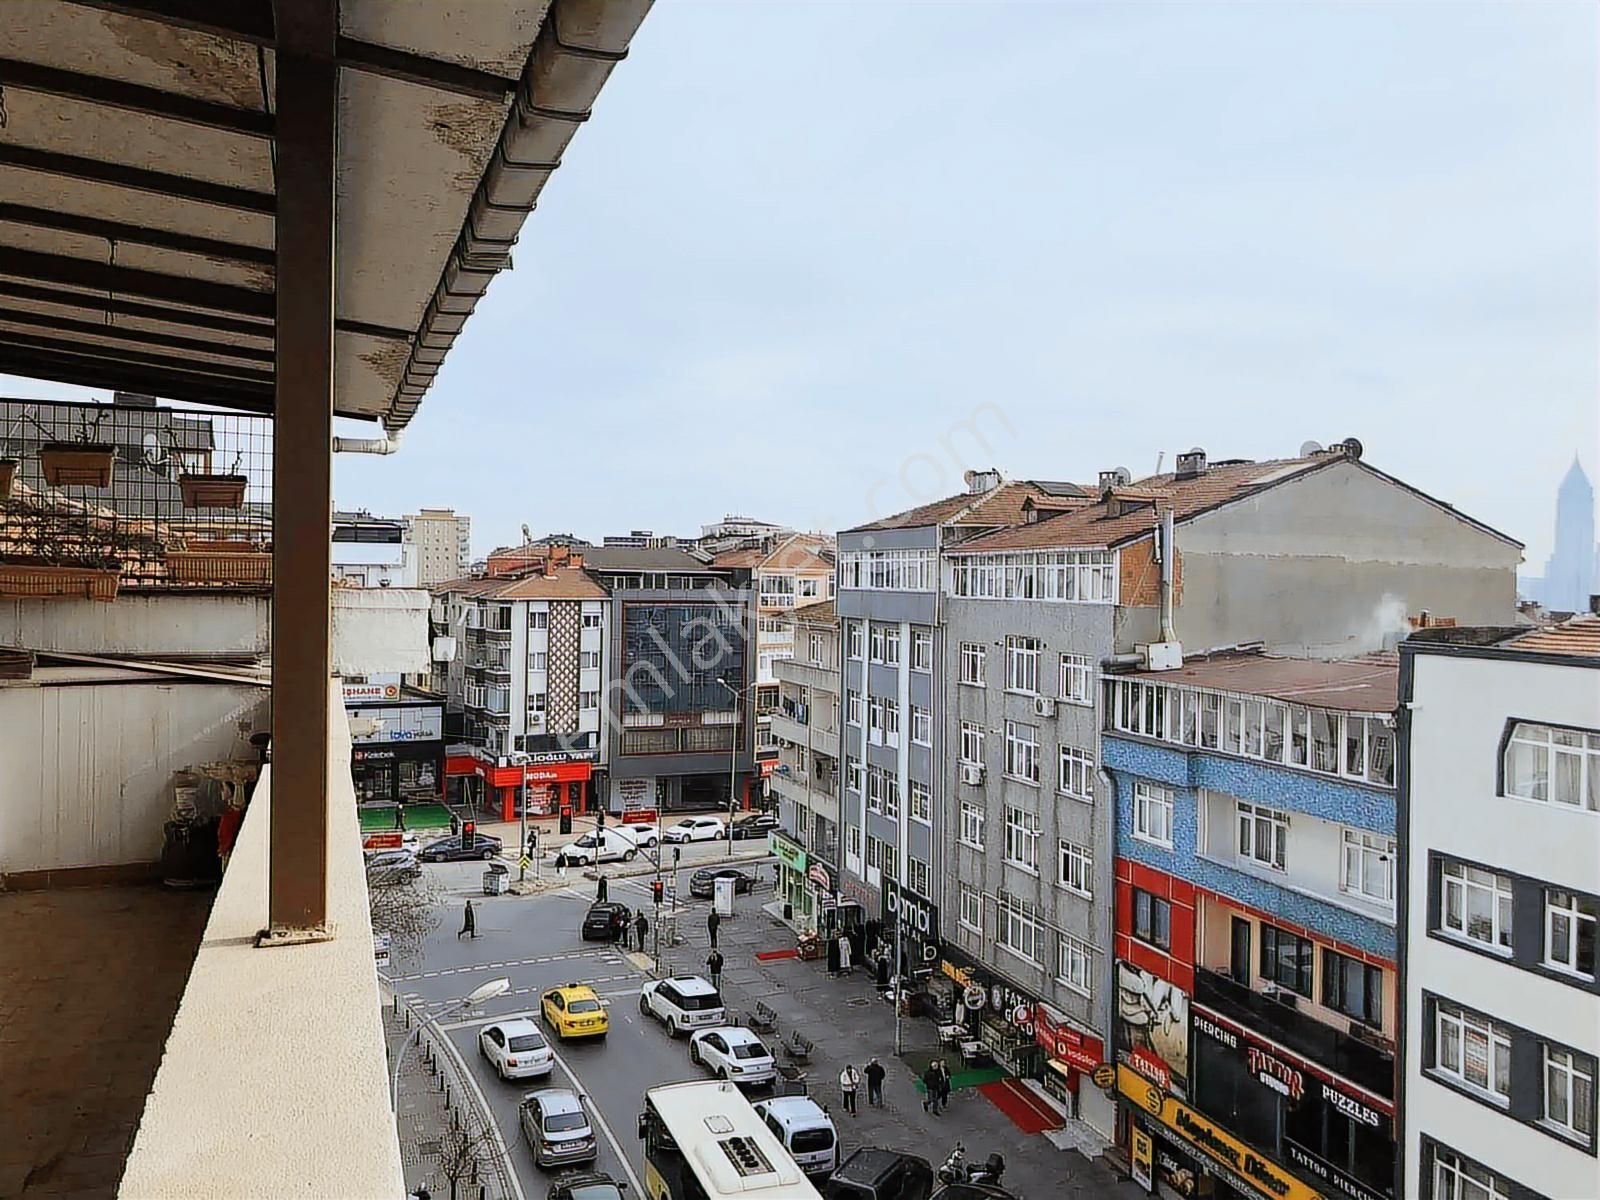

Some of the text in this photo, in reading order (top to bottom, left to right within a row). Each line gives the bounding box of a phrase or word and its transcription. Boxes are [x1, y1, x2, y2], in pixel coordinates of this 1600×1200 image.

[1193, 1016, 1237, 1048] PIERCING
[1322, 1085, 1379, 1127] PUZZLES
[1290, 1147, 1327, 1178] TATTOO
